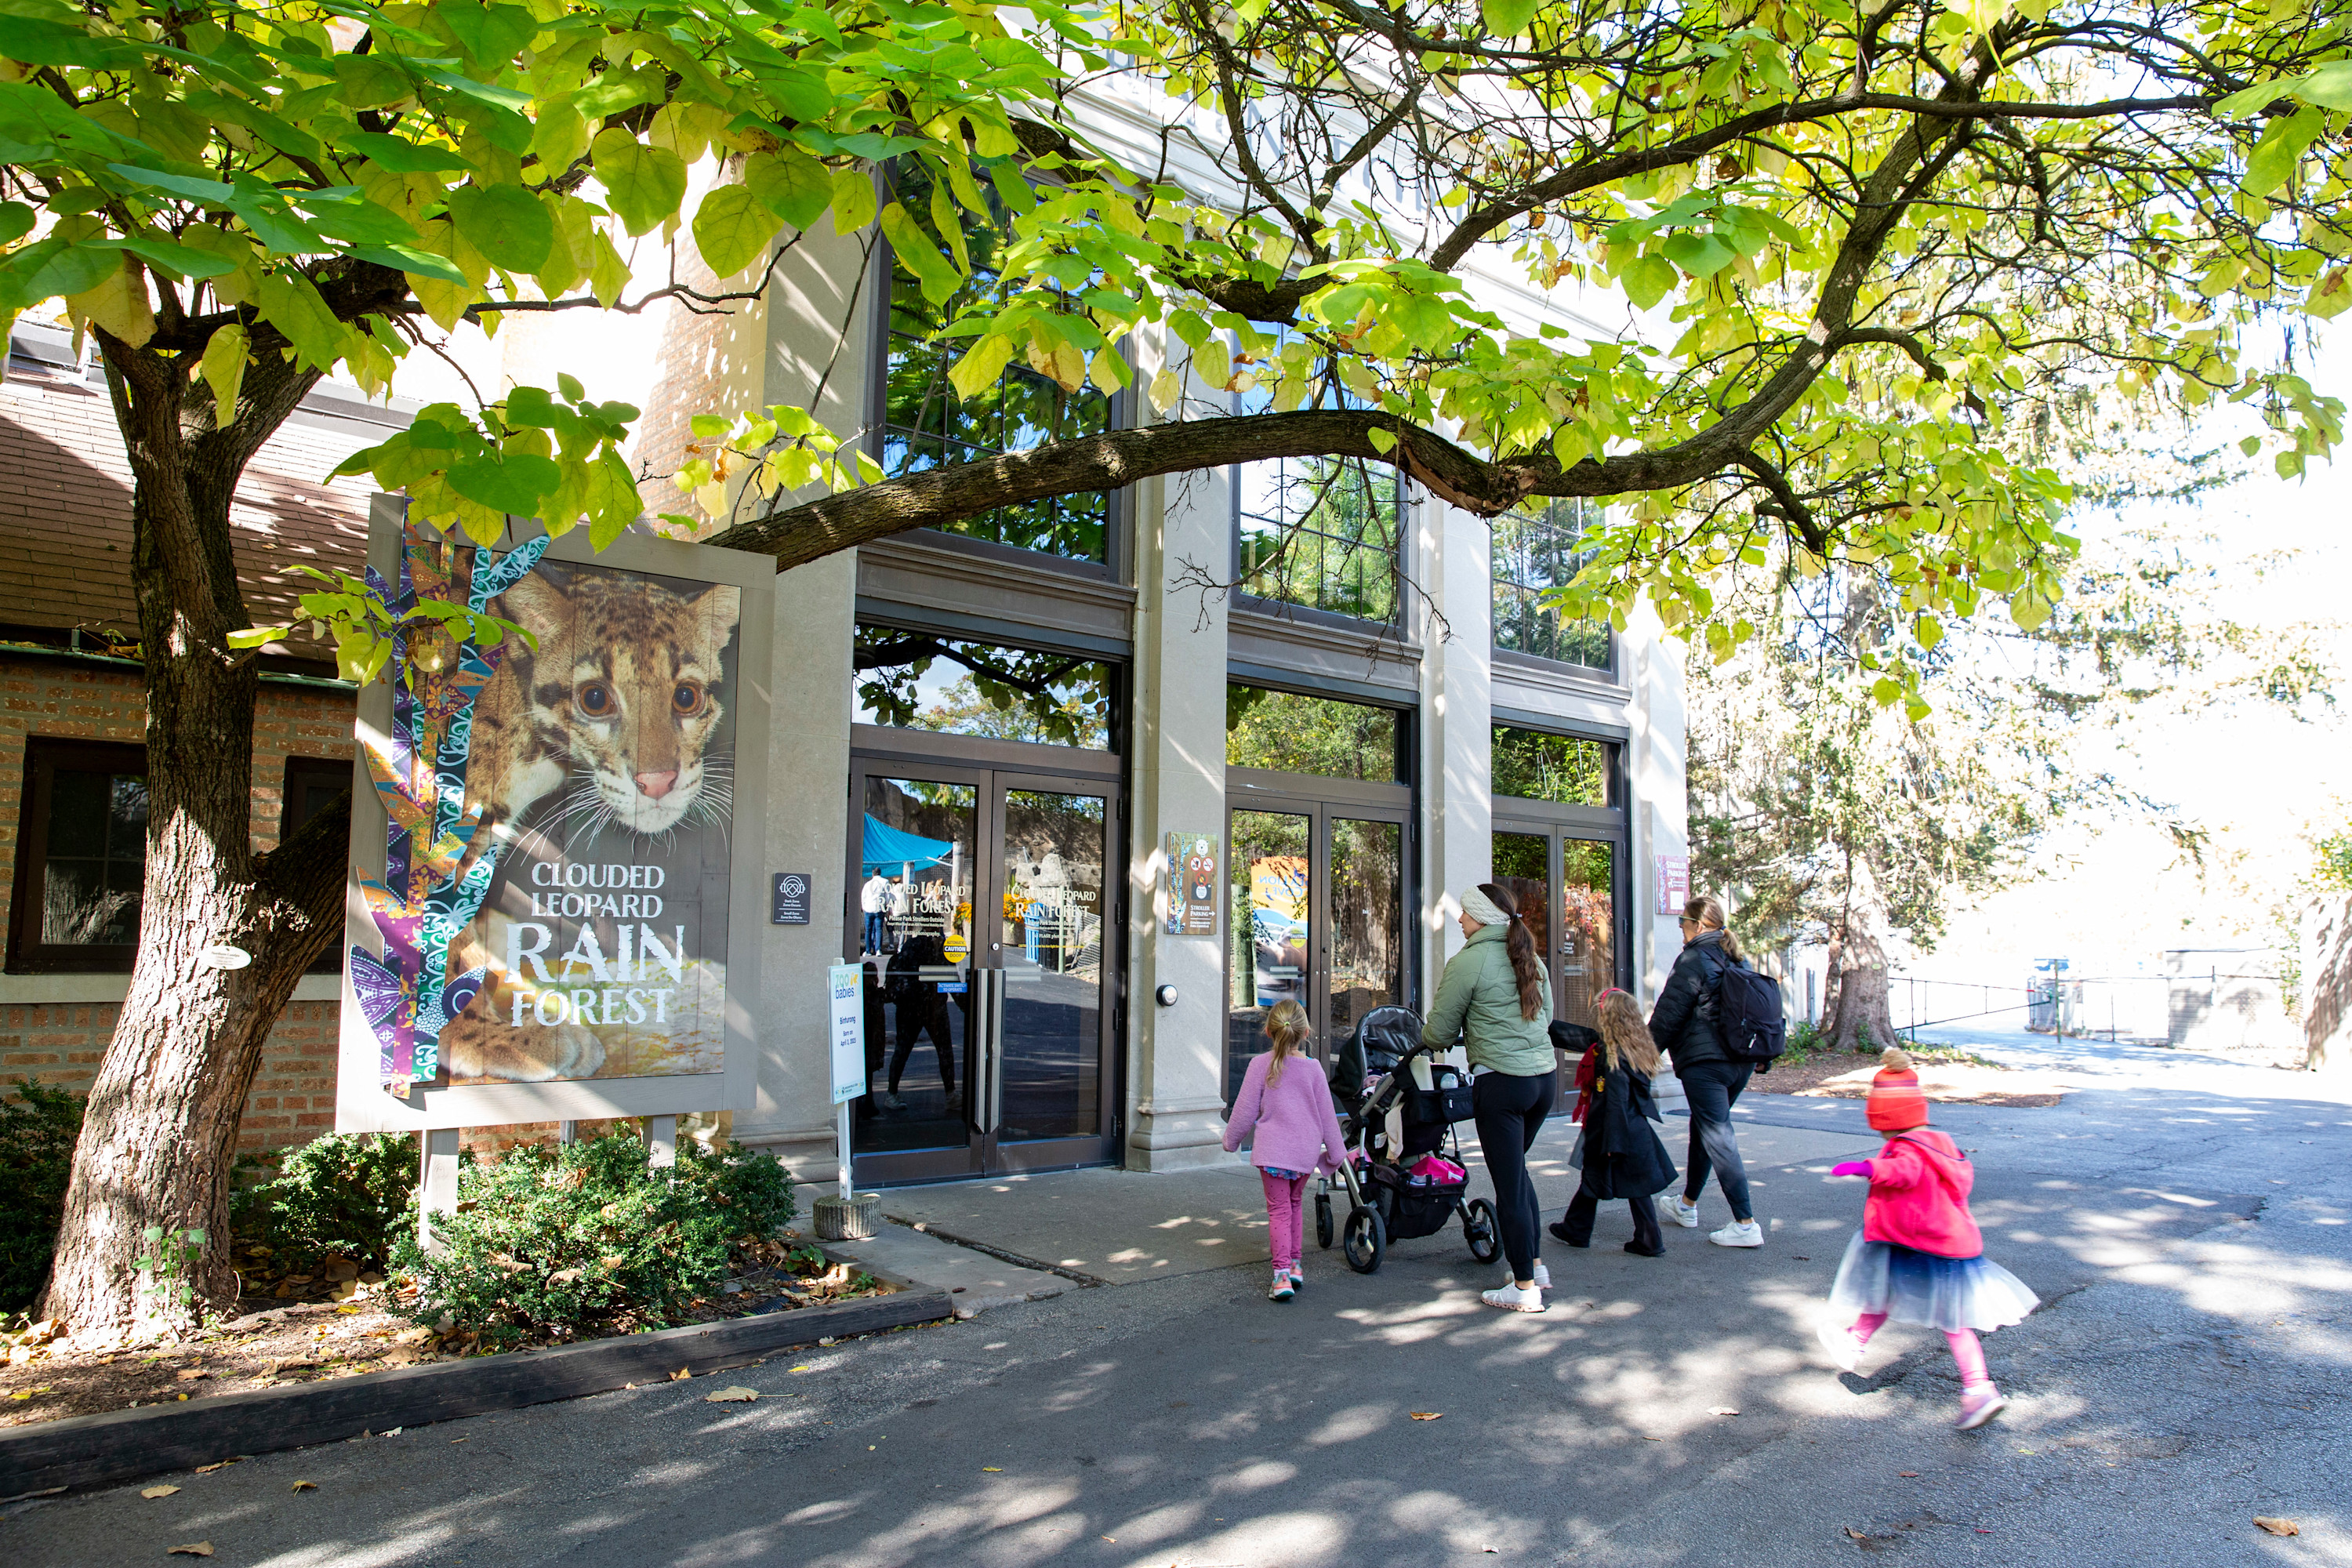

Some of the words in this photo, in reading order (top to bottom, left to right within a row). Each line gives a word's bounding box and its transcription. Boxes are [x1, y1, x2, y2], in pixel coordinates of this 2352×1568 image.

[532, 862, 666, 889] CLOUDED
[1667, 869, 1686, 878] PARKING
[869, 880, 919, 895] CLOUDED
[920, 881, 966, 897] LEOPARD
[531, 892, 663, 918] LEOPARD
[876, 896, 909, 913] RAIN
[913, 898, 960, 914] FOREST
[1015, 902, 1046, 918] RAIN
[1047, 905, 1090, 918] FOREST
[504, 922, 685, 984] RAIN
[836, 974, 849, 988] zoo
[836, 985, 855, 1000] babies
[511, 988, 675, 1027] FOREST
[840, 1016, 856, 1025] Binturong
